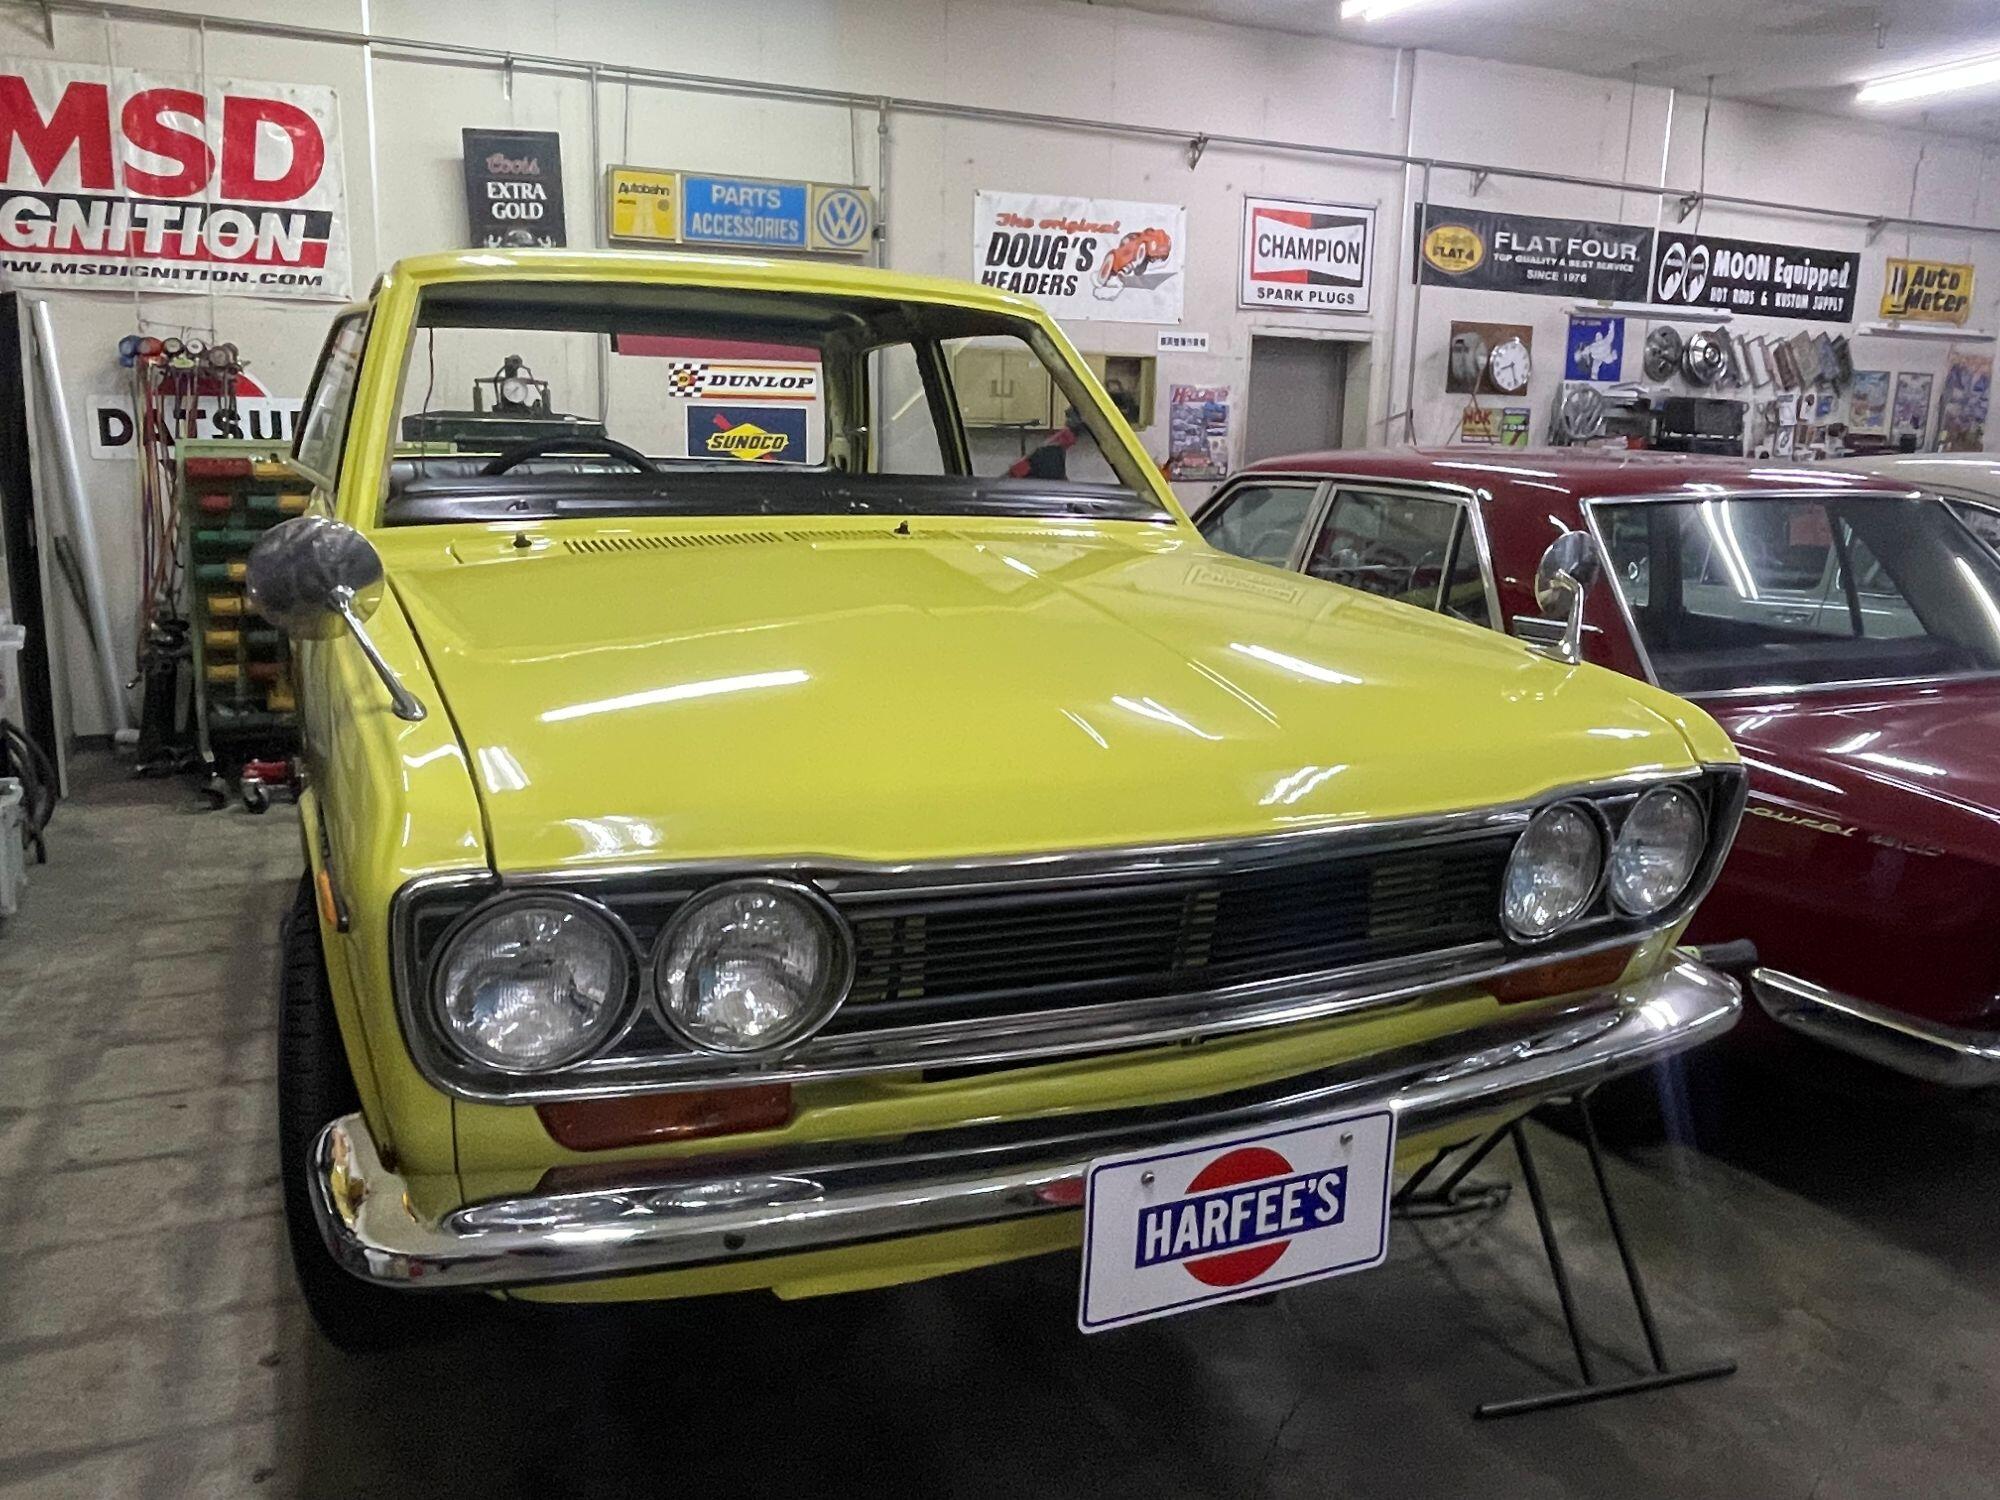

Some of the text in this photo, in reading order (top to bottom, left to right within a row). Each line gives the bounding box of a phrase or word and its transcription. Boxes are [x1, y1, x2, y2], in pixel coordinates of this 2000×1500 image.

[0, 75, 325, 202] MSD
[487, 181, 547, 200] EXTRA
[618, 182, 670, 196] Autobahn
[711, 184, 781, 209] PARTS
[491, 201, 544, 220] GOLD
[692, 212, 799, 241] ACCESSORIES
[995, 212, 1121, 234] The original
[985, 231, 1097, 273] DOUG'S
[1258, 233, 1361, 265] CHAMPION
[1432, 245, 1464, 259] FLAT
[1494, 231, 1562, 254] FLAT
[1566, 239, 1637, 261] FOUR
[2, 259, 323, 287] W.MSDIGNITION.COM
[1493, 253, 1513, 262] TOP
[1514, 254, 1557, 266] QUALITY
[1568, 259, 1594, 269] BEST
[1596, 262, 1634, 273] SERVICE
[1712, 250, 1850, 292] MOON Equipped
[981, 270, 1078, 297] HEADERS
[1526, 269, 1587, 283] SINCE 1976
[1911, 266, 1961, 290] Auto
[1257, 287, 1355, 305] SPARK PLUGS
[1732, 288, 1755, 305] RODS
[1774, 292, 1809, 309] KUSTOM
[1812, 295, 1844, 312] SUPPLY
[1904, 287, 1968, 313] Meter
[708, 374, 814, 389] DUNLOP
[711, 435, 785, 449] SUNOCO
[1144, 1172, 1341, 1261] HARFEE'S
